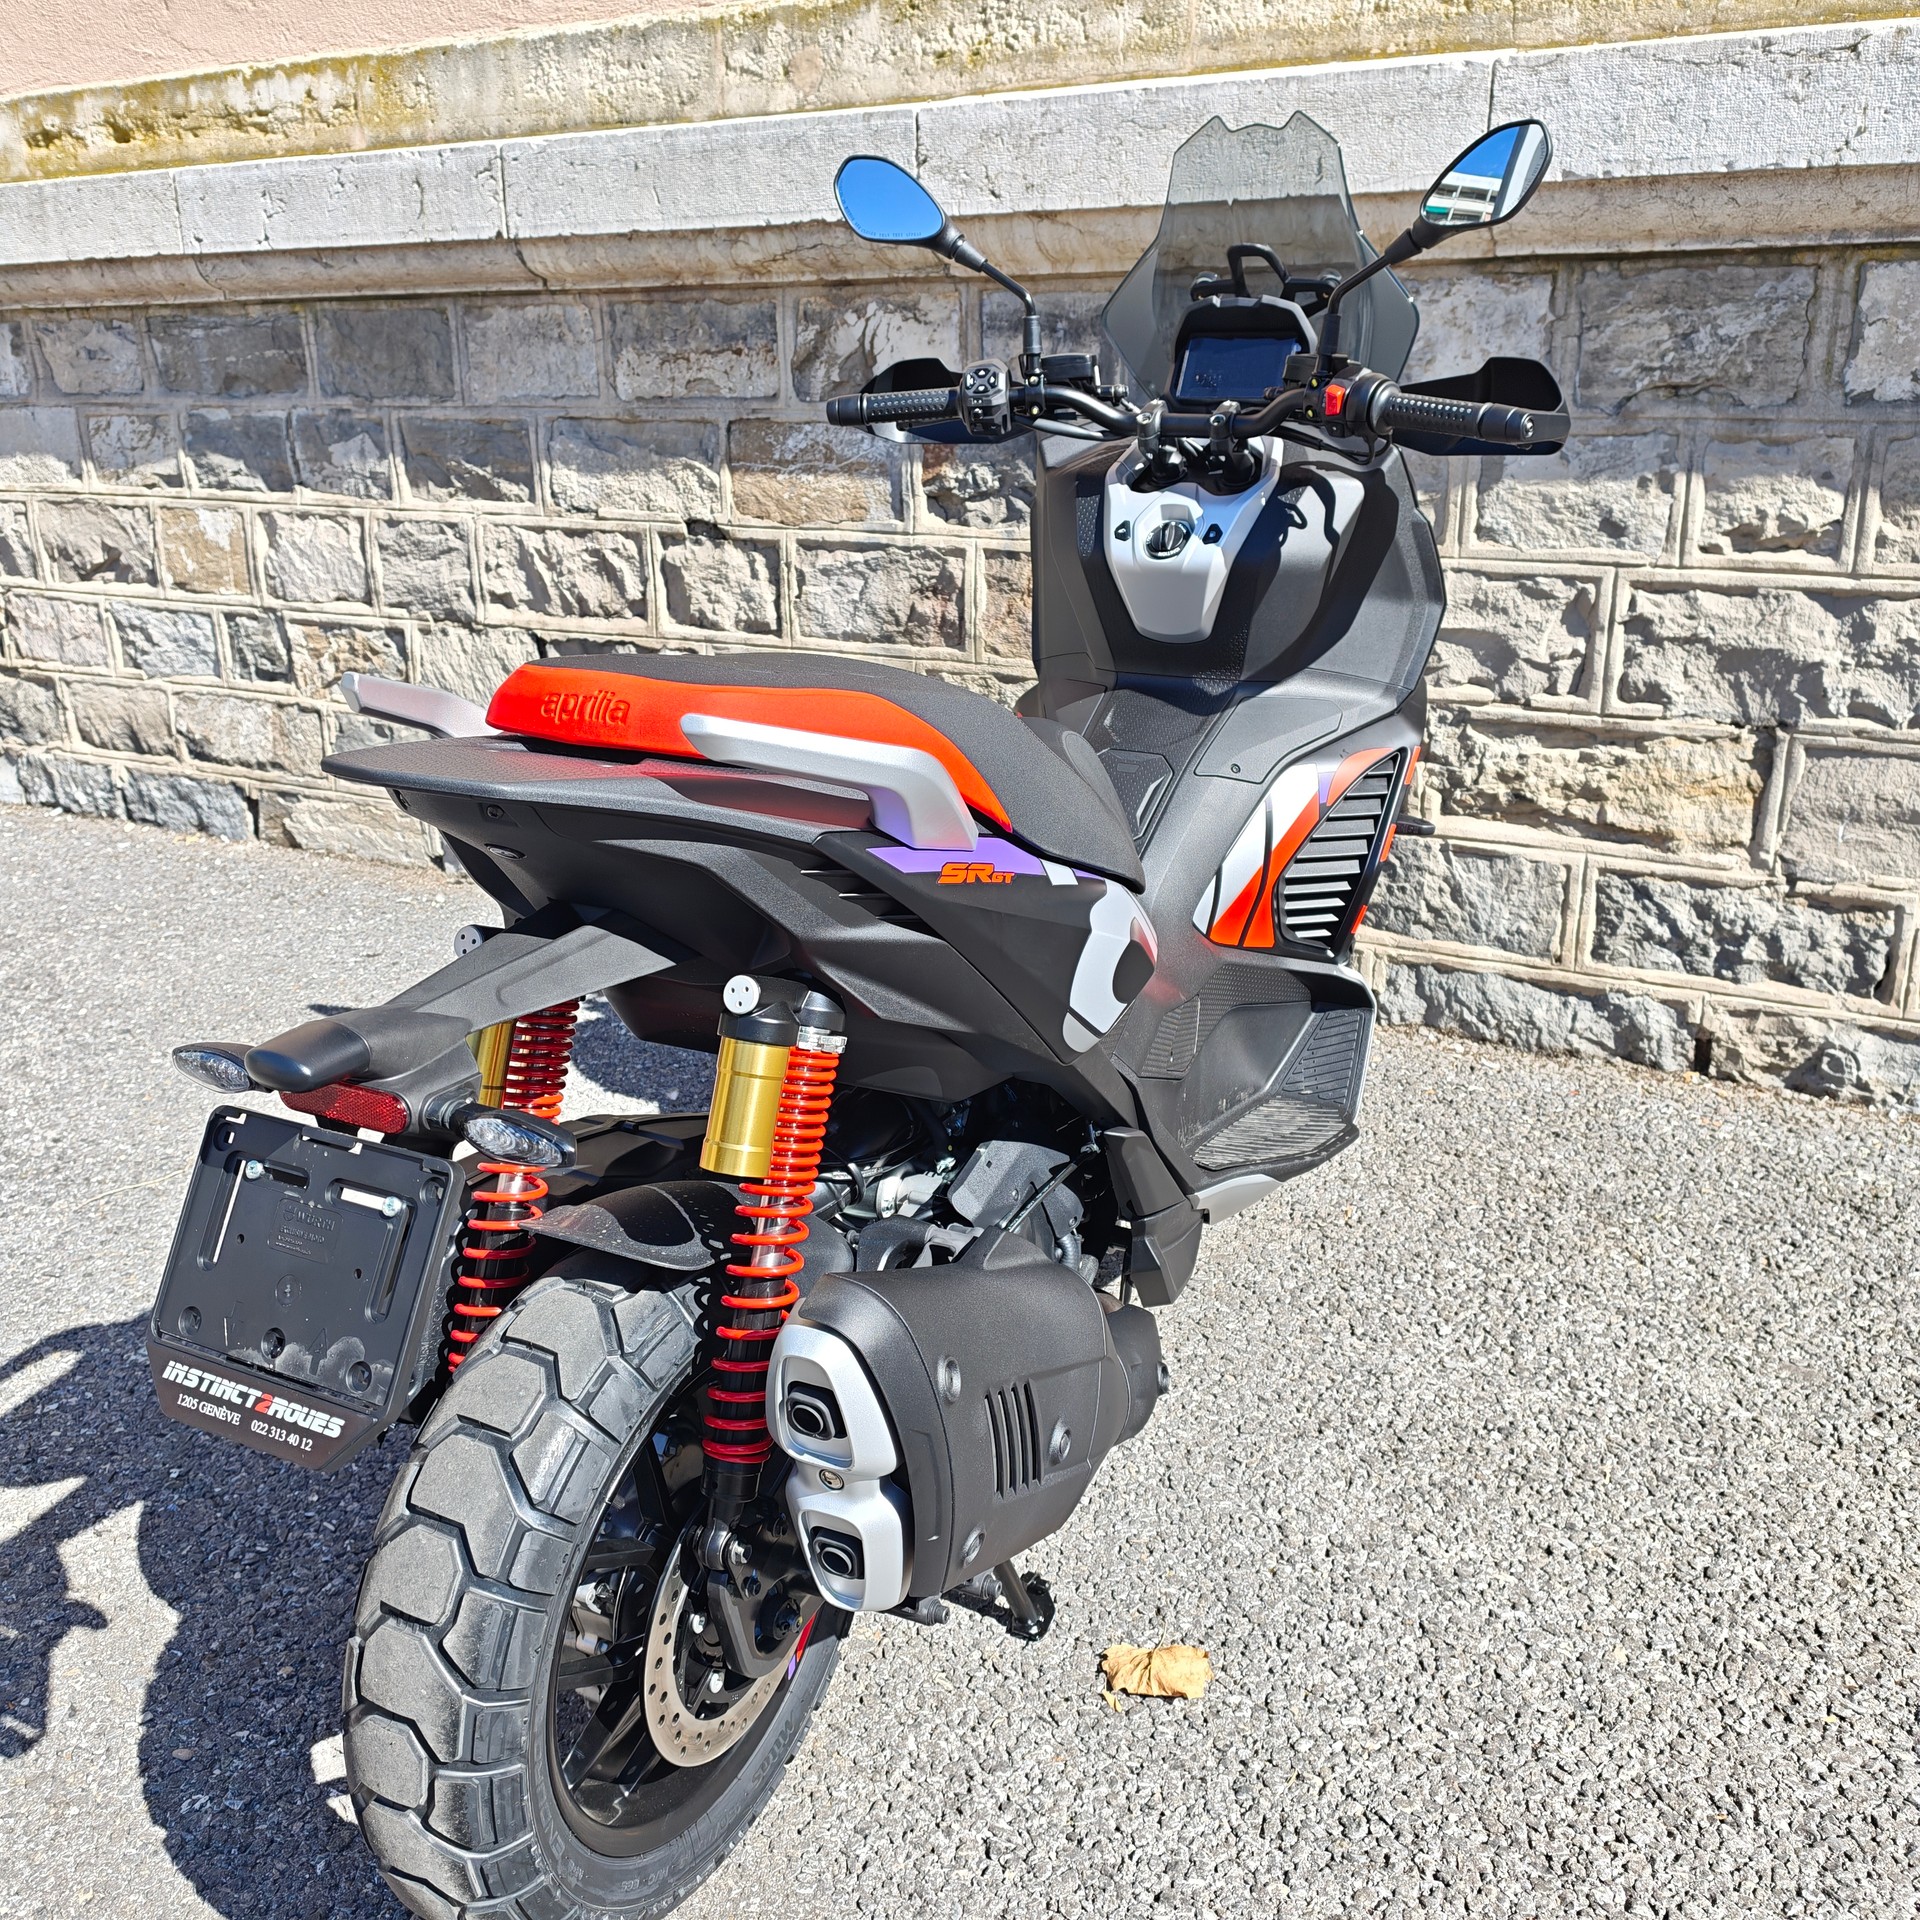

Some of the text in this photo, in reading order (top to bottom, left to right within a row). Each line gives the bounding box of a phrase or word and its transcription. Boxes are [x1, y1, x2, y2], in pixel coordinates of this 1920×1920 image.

[540, 689, 630, 726] aprilia
[177, 1393, 314, 1452] 1205 GENÈVE 022 313 40 12
